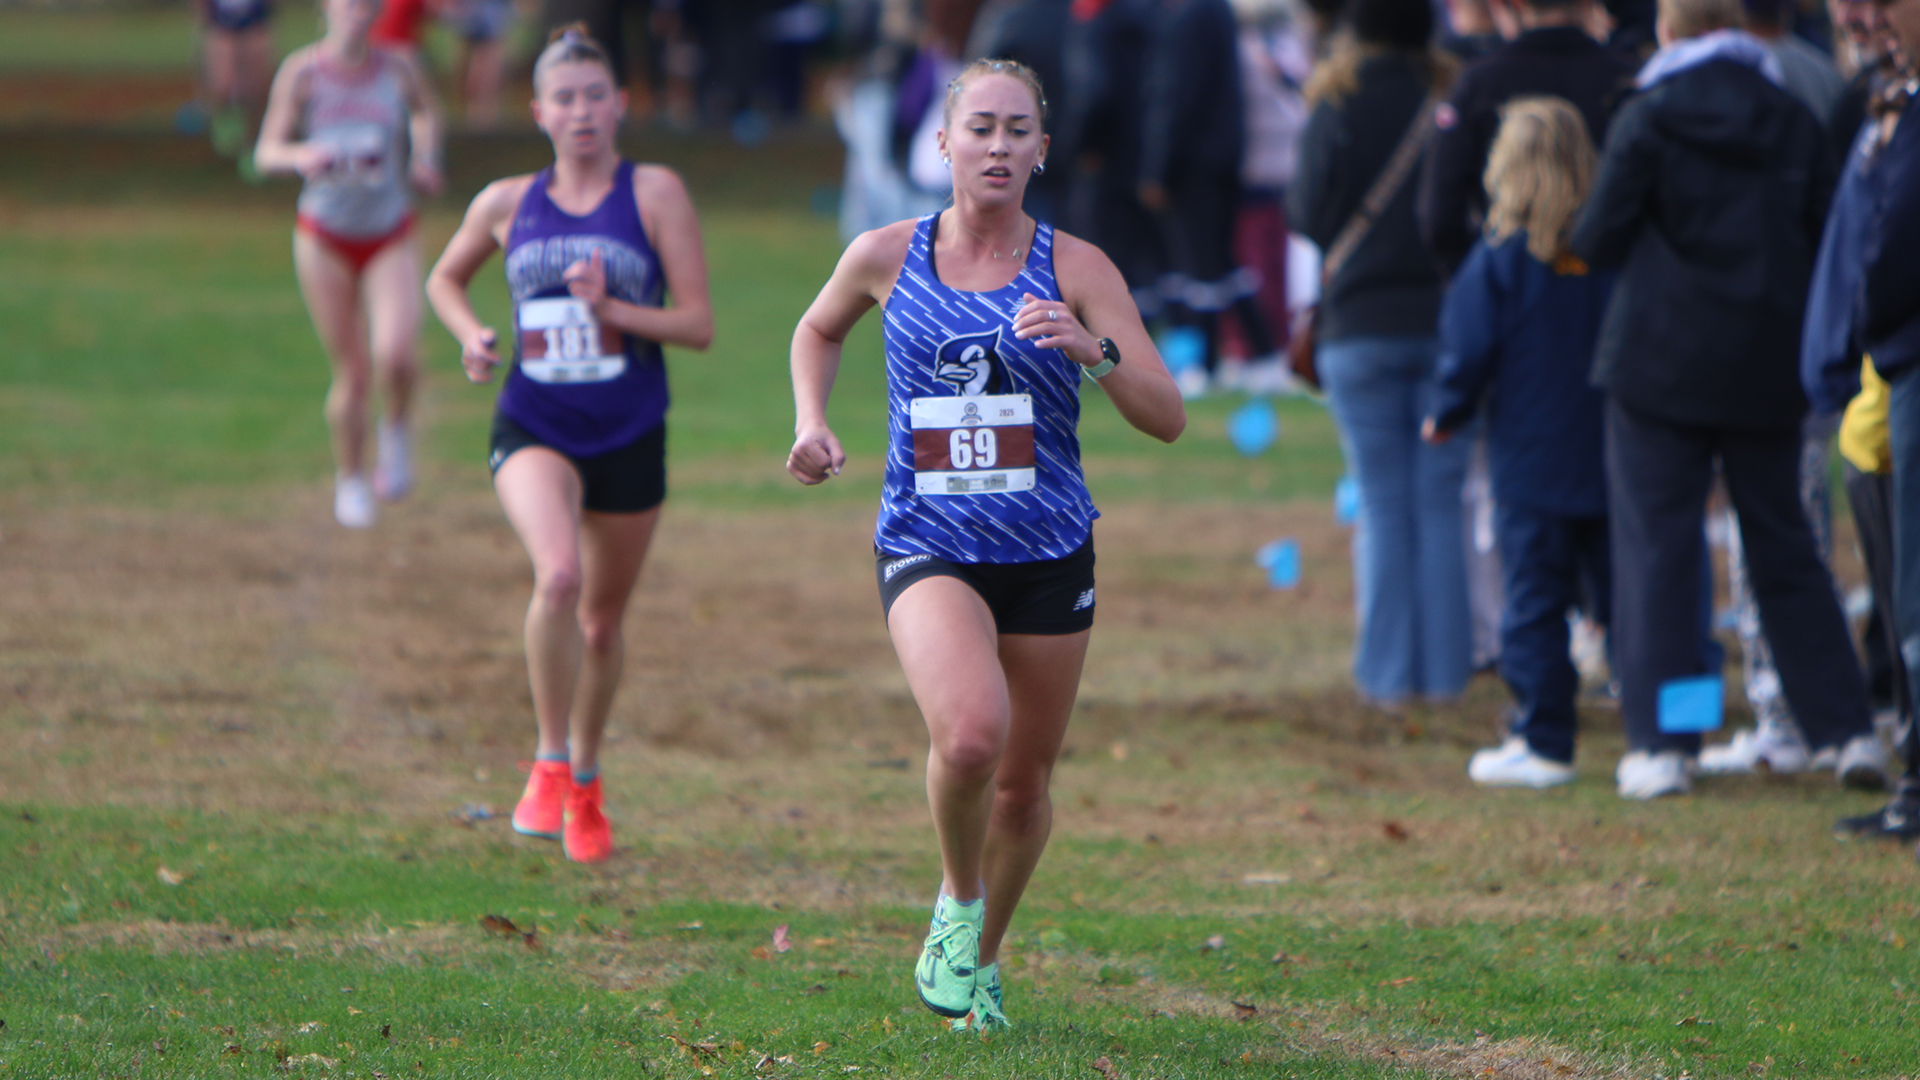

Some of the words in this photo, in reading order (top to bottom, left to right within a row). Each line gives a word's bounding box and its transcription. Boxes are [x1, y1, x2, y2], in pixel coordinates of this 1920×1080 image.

[543, 326, 600, 361] 181
[999, 408, 1014, 417] 2025
[949, 428, 997, 469] 69
